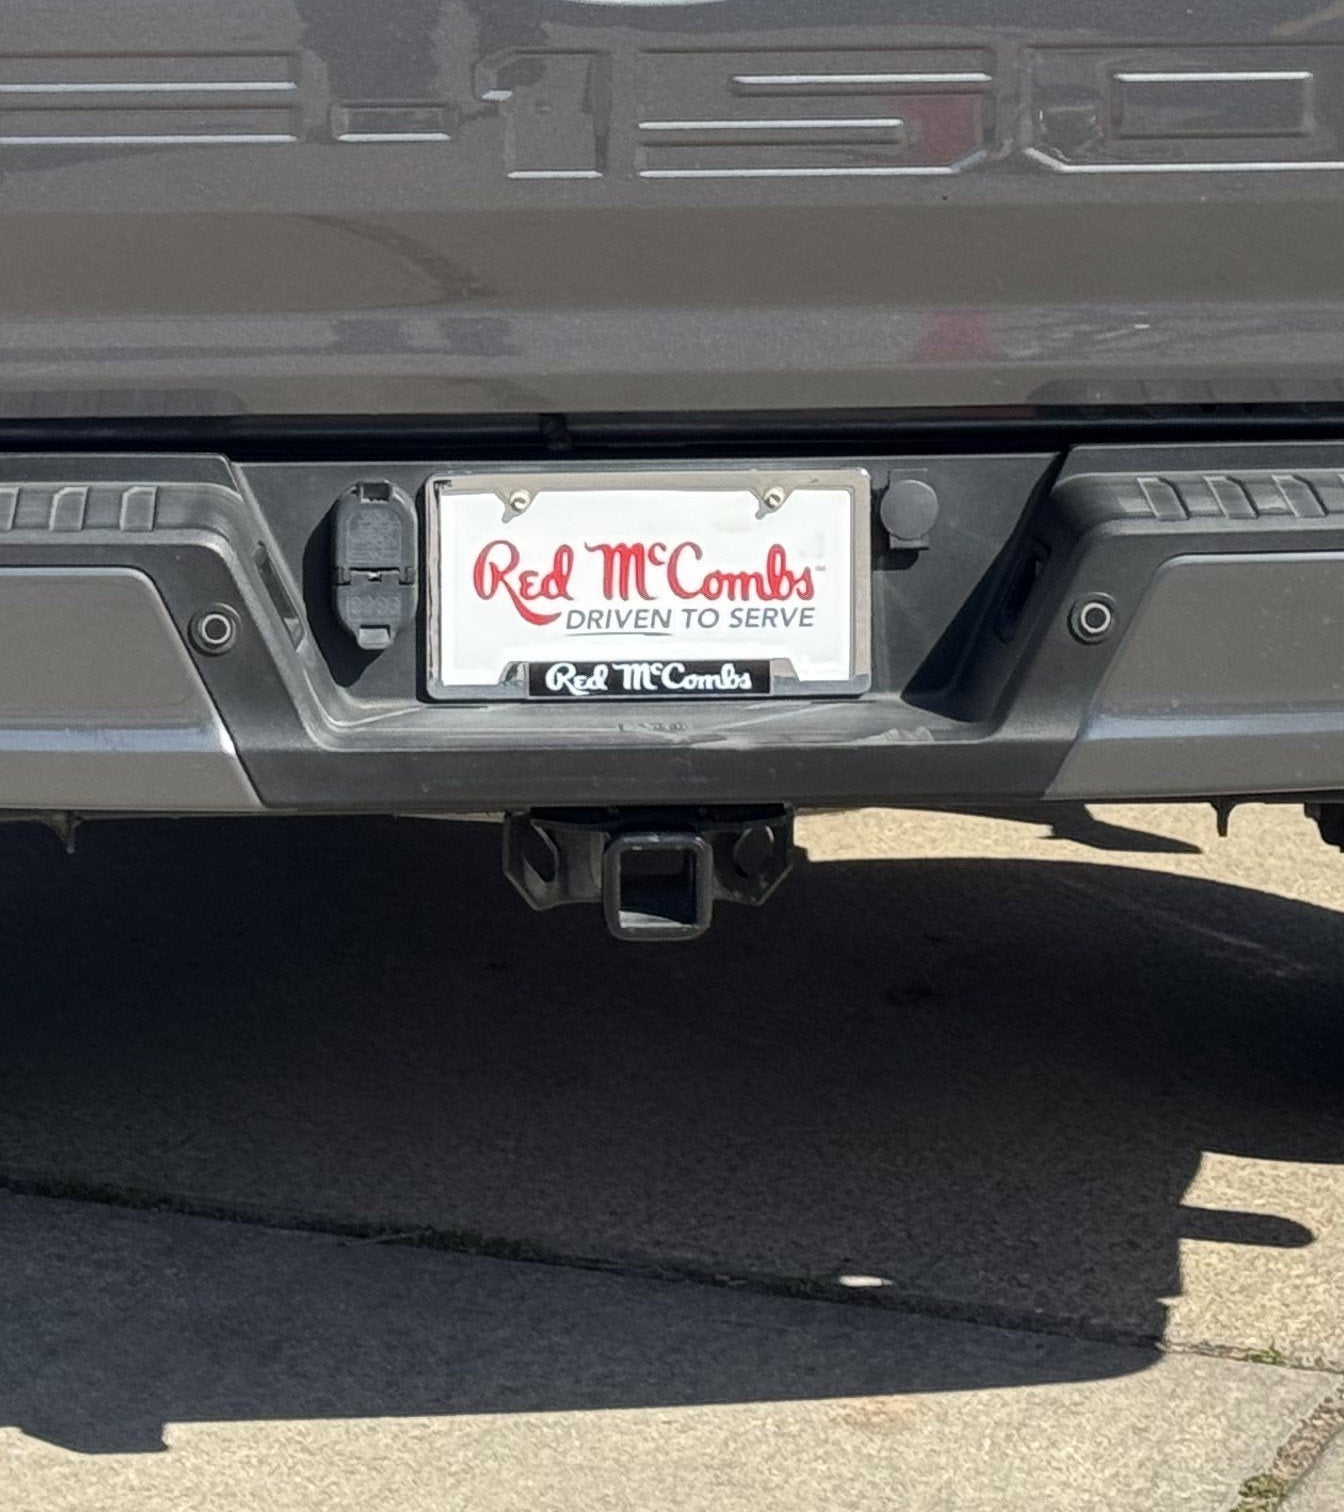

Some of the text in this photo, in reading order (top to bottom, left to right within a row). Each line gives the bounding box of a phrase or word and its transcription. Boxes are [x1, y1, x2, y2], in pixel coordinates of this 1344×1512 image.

[473, 539, 815, 626] Red McCombs
[566, 607, 816, 630] DRIVEN TO SERVE
[545, 662, 752, 695] Red McCombs
